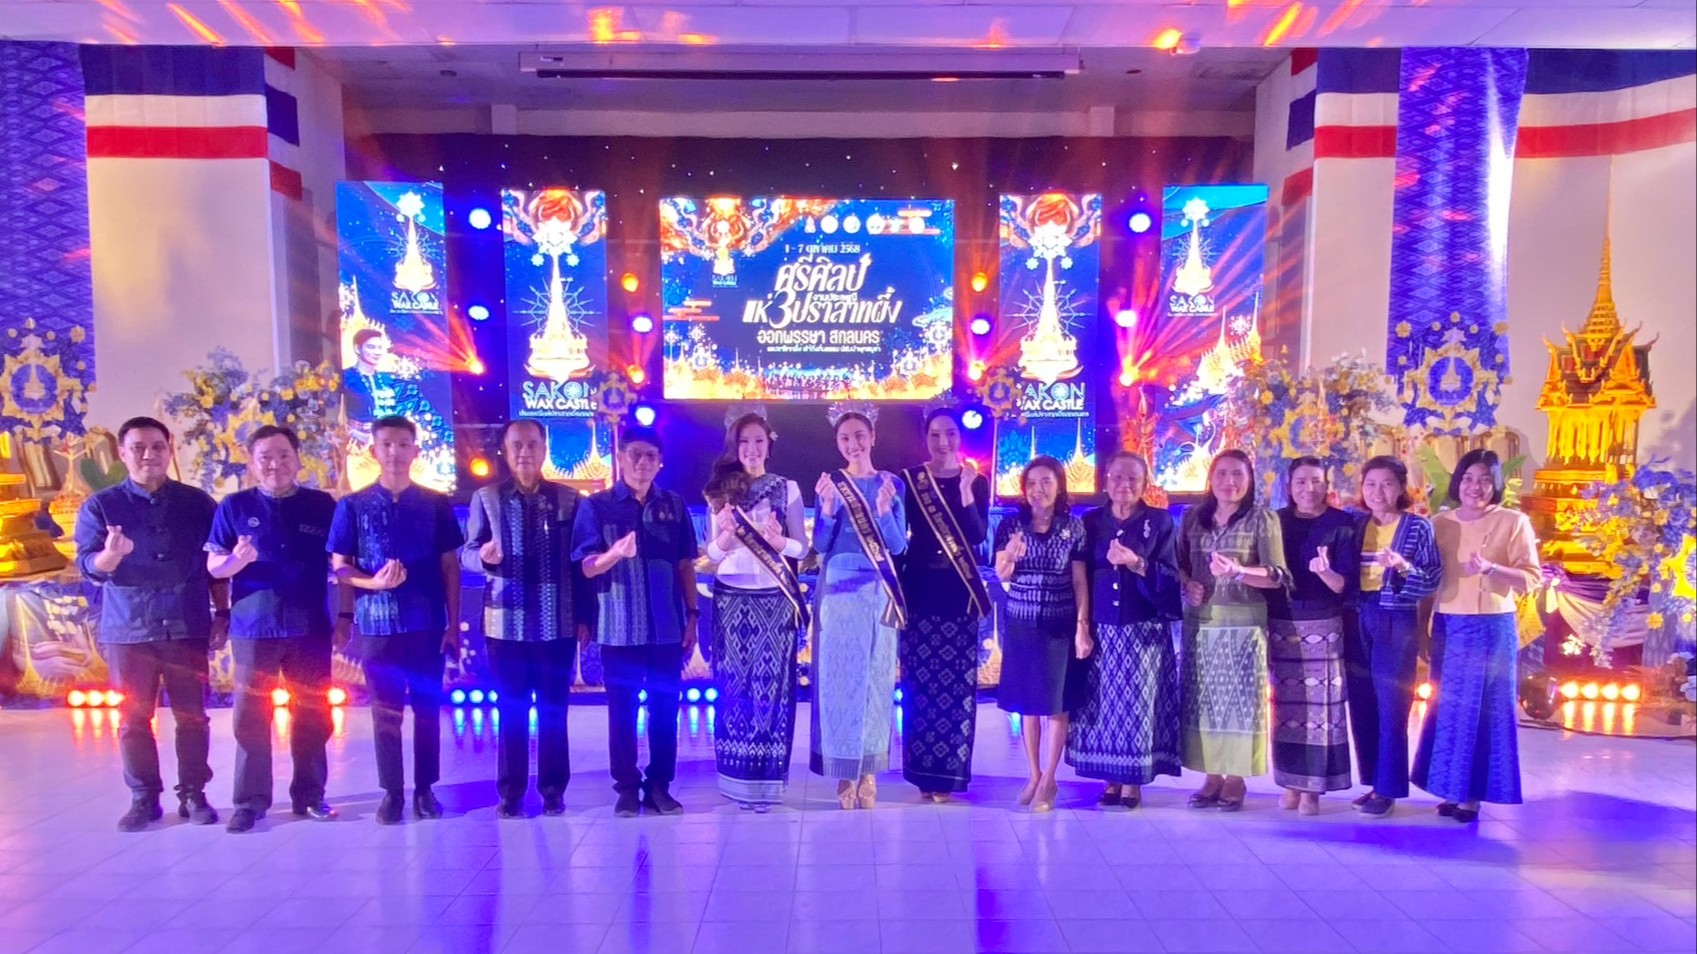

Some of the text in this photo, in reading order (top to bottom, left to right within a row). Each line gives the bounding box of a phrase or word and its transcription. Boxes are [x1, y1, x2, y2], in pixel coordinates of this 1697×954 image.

[829, 329, 881, 344] สกลนคร
[1042, 399, 1084, 410] CASTLE
